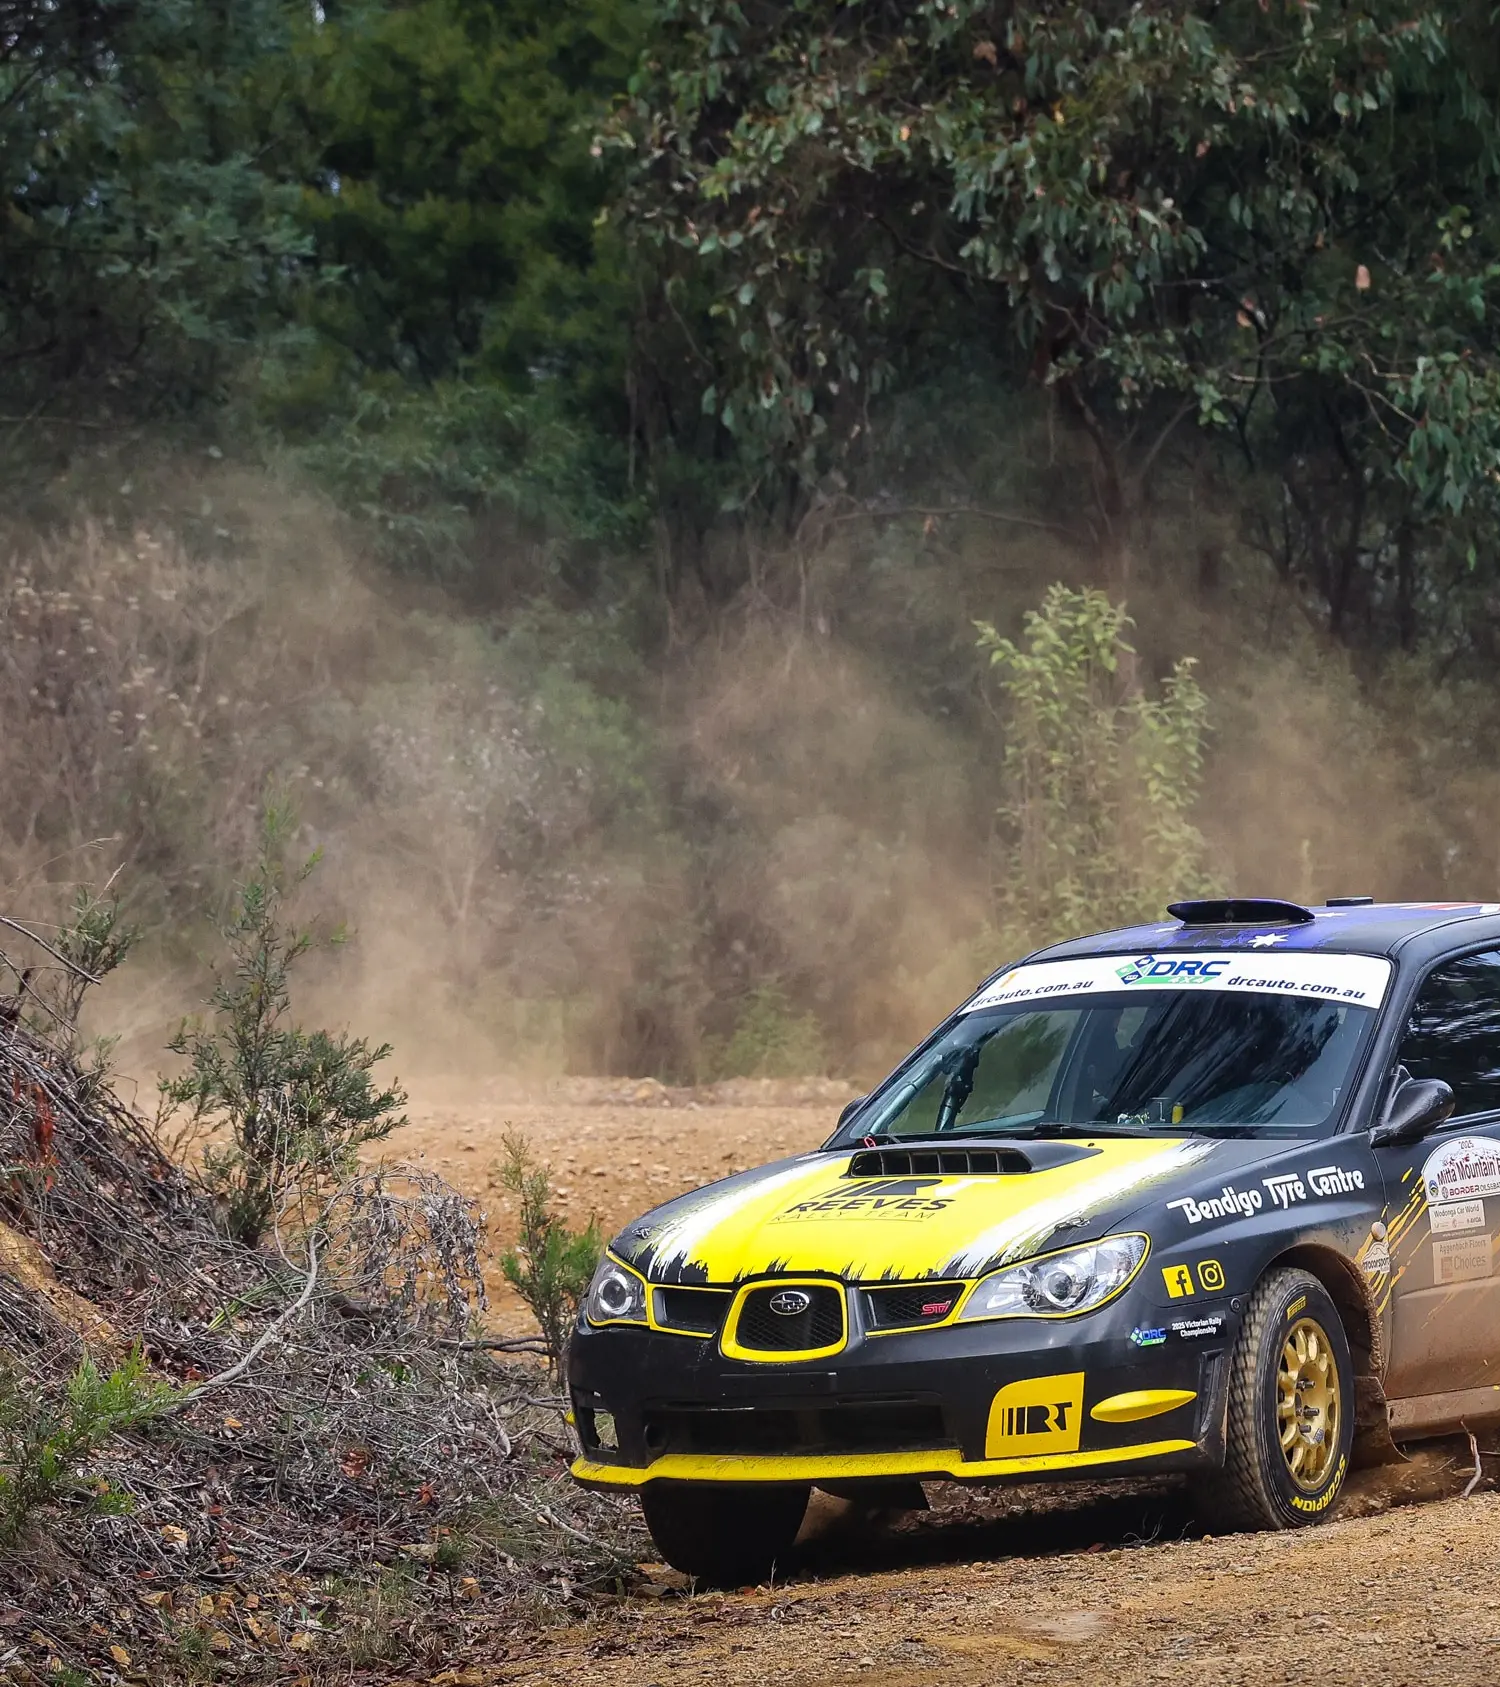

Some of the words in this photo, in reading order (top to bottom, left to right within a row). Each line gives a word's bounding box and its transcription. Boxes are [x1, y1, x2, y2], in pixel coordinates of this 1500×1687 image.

[1149, 960, 1232, 976] DRC
[970, 980, 1095, 1008] drcauto.com.au
[1226, 974, 1366, 1000] drcauto.com.au
[1436, 1168, 1458, 1186] Mitta
[1455, 1157, 1497, 1181] Mountain
[1166, 1186, 1263, 1225] Bendigo
[1261, 1172, 1307, 1210] Tyre
[1306, 1165, 1365, 1197] Centre
[1449, 1184, 1480, 1197] BORDER
[784, 1198, 956, 1213] REEVES
[1433, 1207, 1457, 1218] Wodonga
[1456, 1206, 1465, 1215] Car
[1465, 1204, 1480, 1213] World
[771, 1210, 846, 1222] RALLY
[863, 1210, 937, 1220] TEAM
[1453, 1253, 1487, 1271] Choices
[1184, 1318, 1209, 1329] Victorian
[1289, 1453, 1346, 1512] SCORPION
